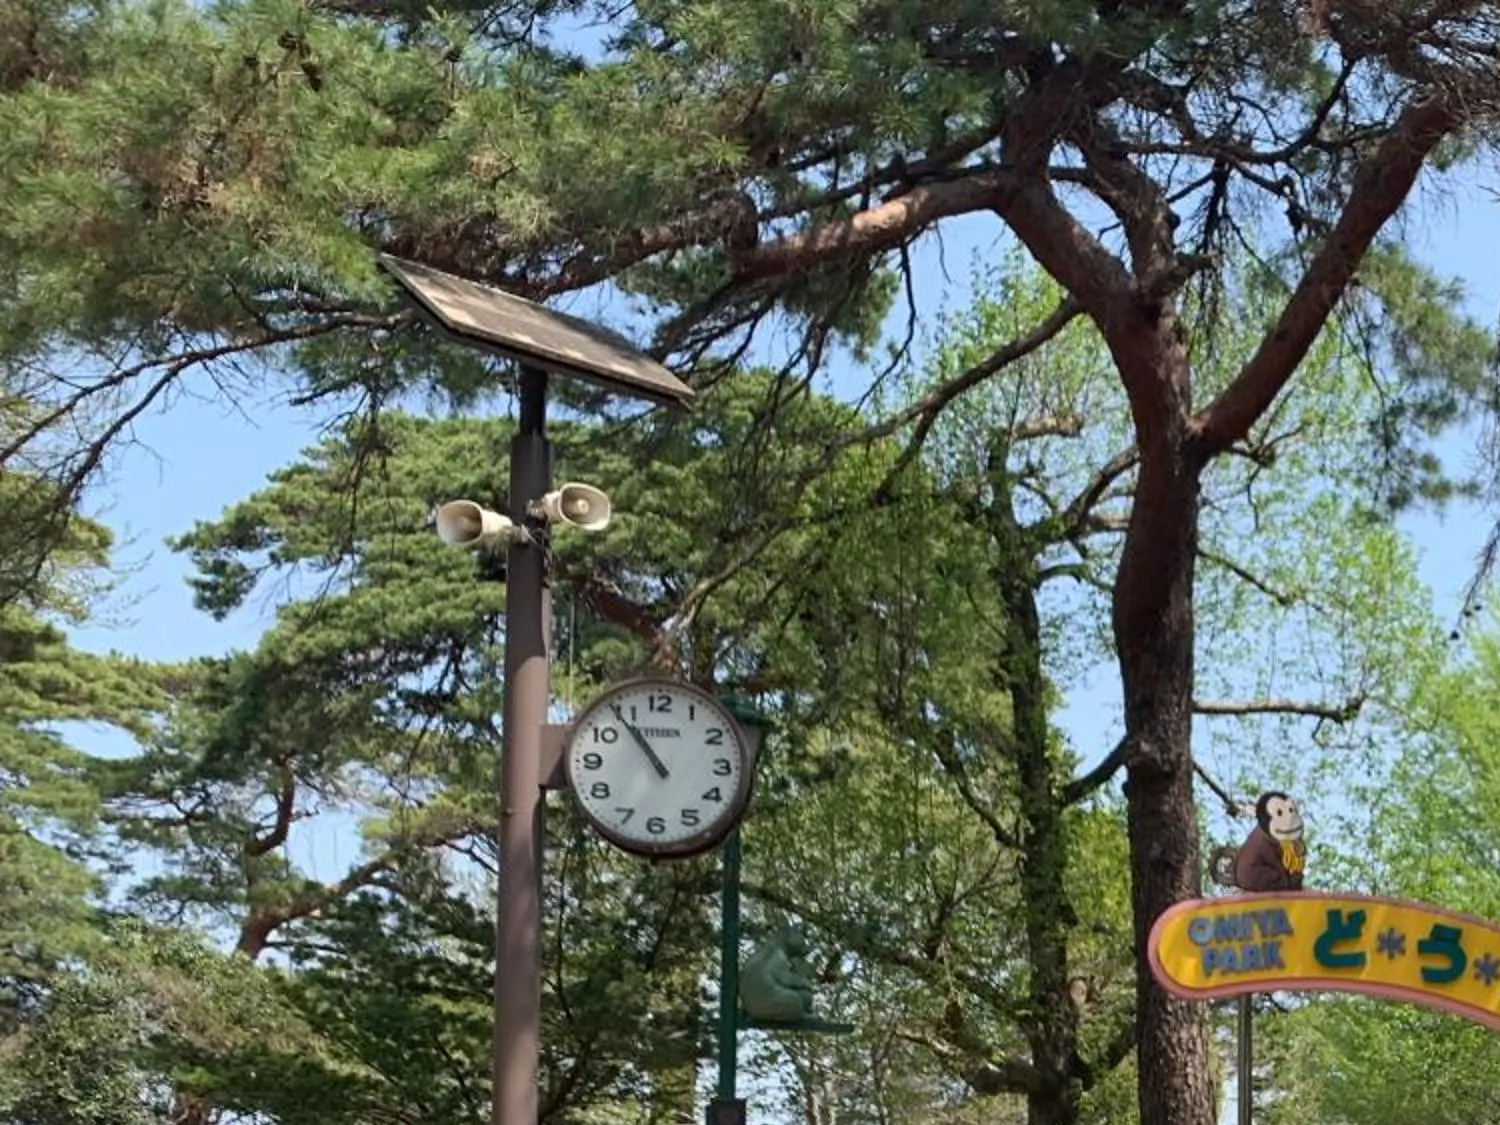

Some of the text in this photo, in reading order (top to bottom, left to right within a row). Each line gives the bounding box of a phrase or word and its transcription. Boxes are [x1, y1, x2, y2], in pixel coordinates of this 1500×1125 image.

[648, 695, 673, 713] 12
[689, 705, 695, 721] 1
[593, 727, 619, 744] 10
[704, 728, 723, 745] 2
[583, 753, 603, 770] 9
[712, 758, 732, 776] 3
[591, 782, 611, 799] 8
[702, 787, 722, 803] 4
[615, 808, 635, 824] 7
[681, 809, 700, 826] 5
[646, 817, 666, 834] 6
[1187, 908, 1294, 946] OMIYA
[1202, 940, 1285, 978] PARK
